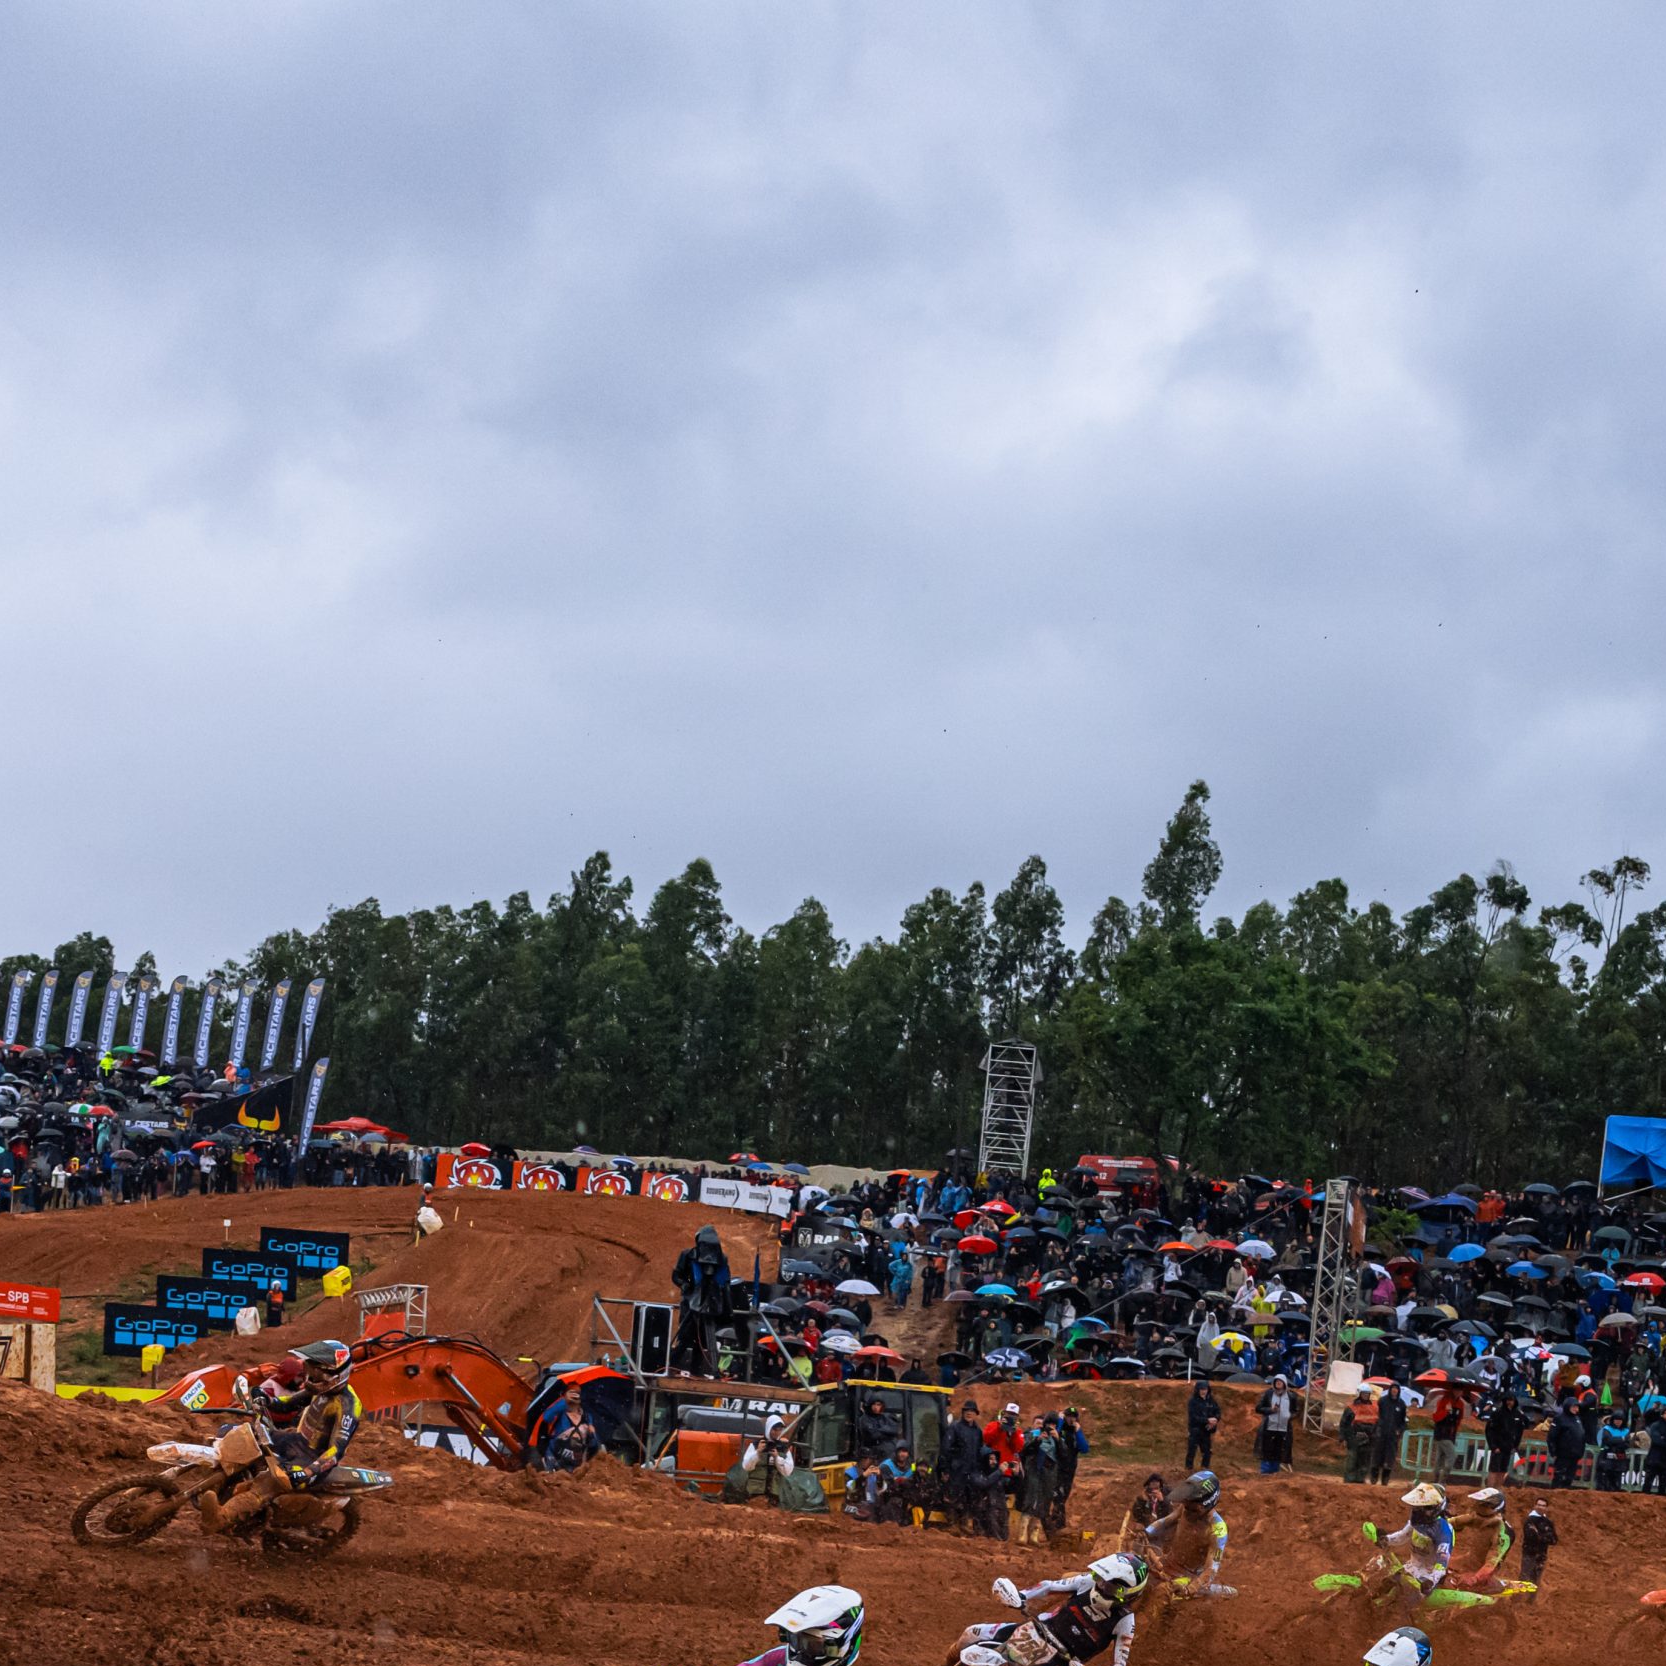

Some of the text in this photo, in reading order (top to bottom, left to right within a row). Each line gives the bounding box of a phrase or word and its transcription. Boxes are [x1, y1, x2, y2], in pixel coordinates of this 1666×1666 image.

[267, 1239, 339, 1257] GoPro
[212, 1260, 289, 1278] GoPro
[7, 1290, 30, 1304] SPB
[166, 1288, 247, 1306] GoPro
[115, 1316, 198, 1335] GoPro
